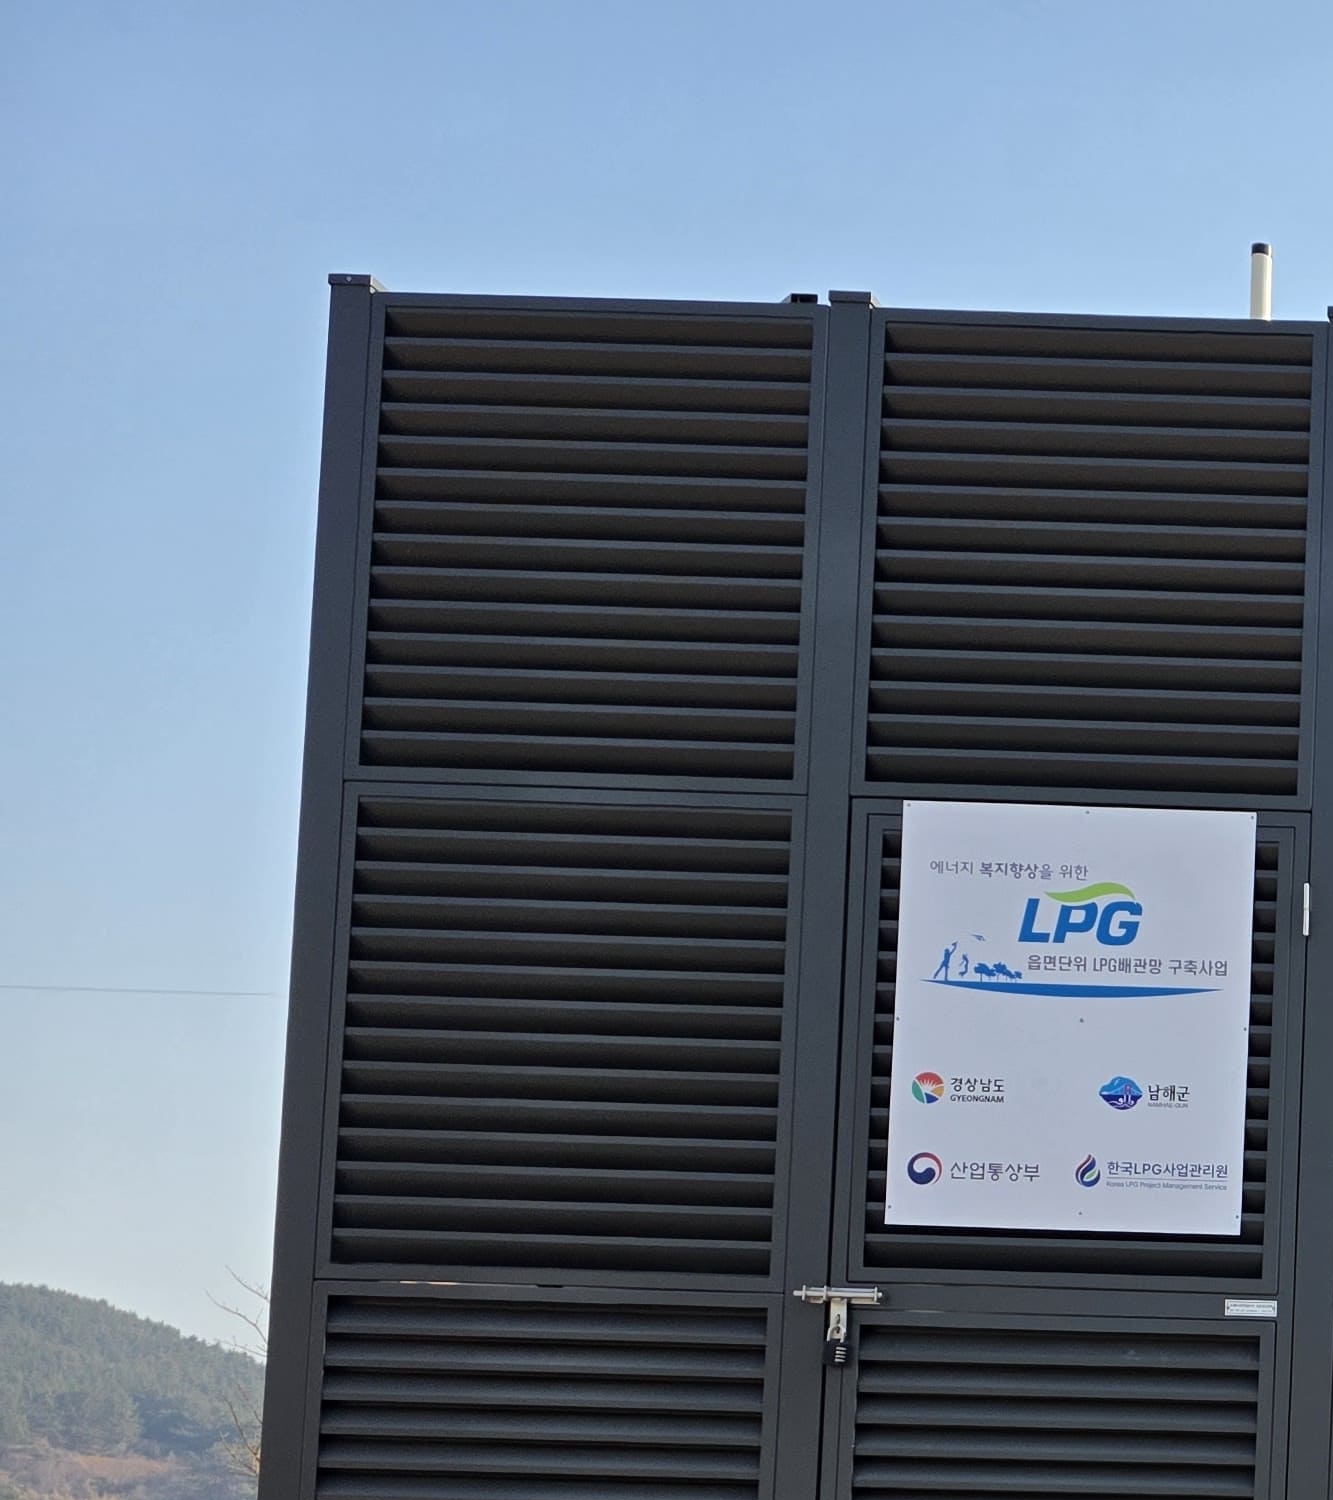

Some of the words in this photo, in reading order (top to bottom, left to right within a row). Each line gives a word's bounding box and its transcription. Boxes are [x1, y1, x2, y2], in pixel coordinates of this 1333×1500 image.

[930, 861, 973, 875] 에너지
[979, 862, 1053, 880] 복지향상을
[1059, 865, 1088, 881] 위한
[1017, 897, 1143, 945] LPG
[1028, 955, 1086, 972] 읍면단위
[1093, 957, 1162, 975] LPG배관망
[1168, 960, 1227, 976] 구축사업
[951, 1077, 1005, 1093] 경상남도
[1148, 1085, 1190, 1102] 남해군
[950, 1094, 1004, 1103] GYEONGNAM
[951, 1162, 1040, 1182] 산업통상부
[1107, 1160, 1228, 1178] 한국LPG사업관리원
